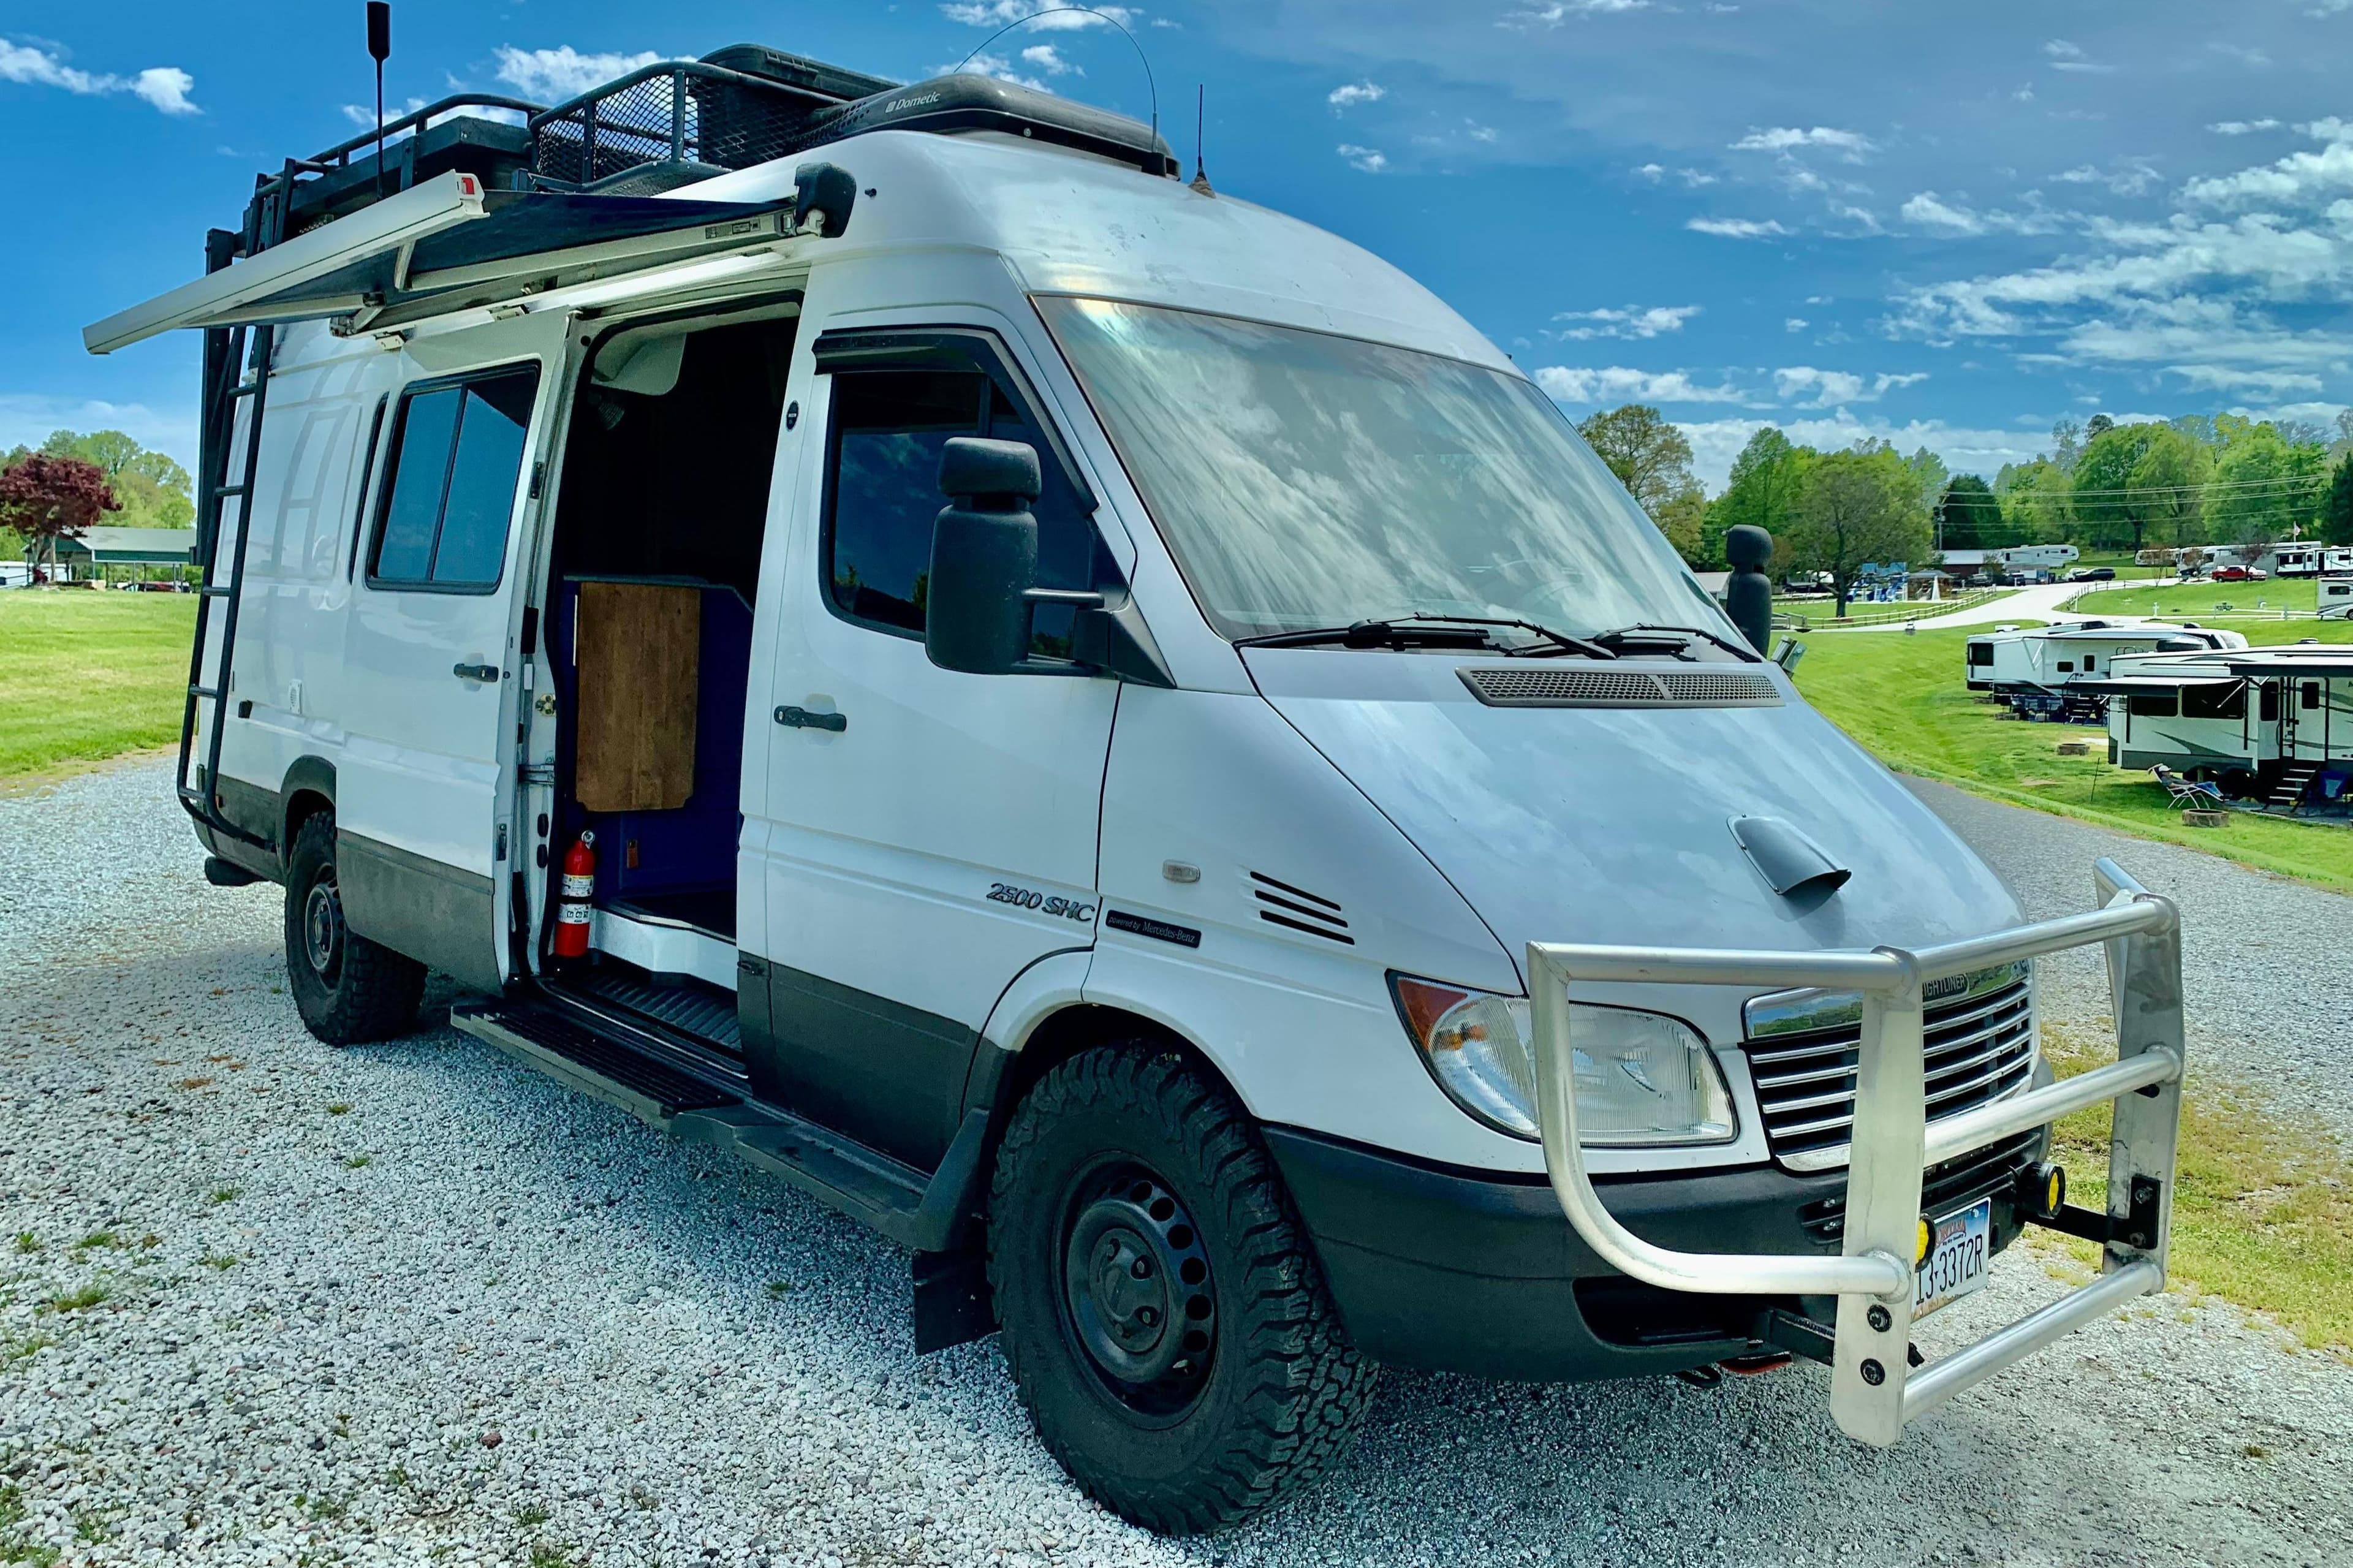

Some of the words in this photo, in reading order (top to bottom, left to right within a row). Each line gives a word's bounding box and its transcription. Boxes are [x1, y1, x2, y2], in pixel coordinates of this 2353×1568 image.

[895, 91, 941, 110] Dometic
[986, 882, 1042, 909] 2500
[1042, 895, 1095, 922] SHC
[1108, 917, 1132, 928] powered
[1132, 921, 1141, 931] by
[1142, 921, 1195, 944] Mercedes-Benz
[1923, 974, 1965, 998] IGHTLINER
